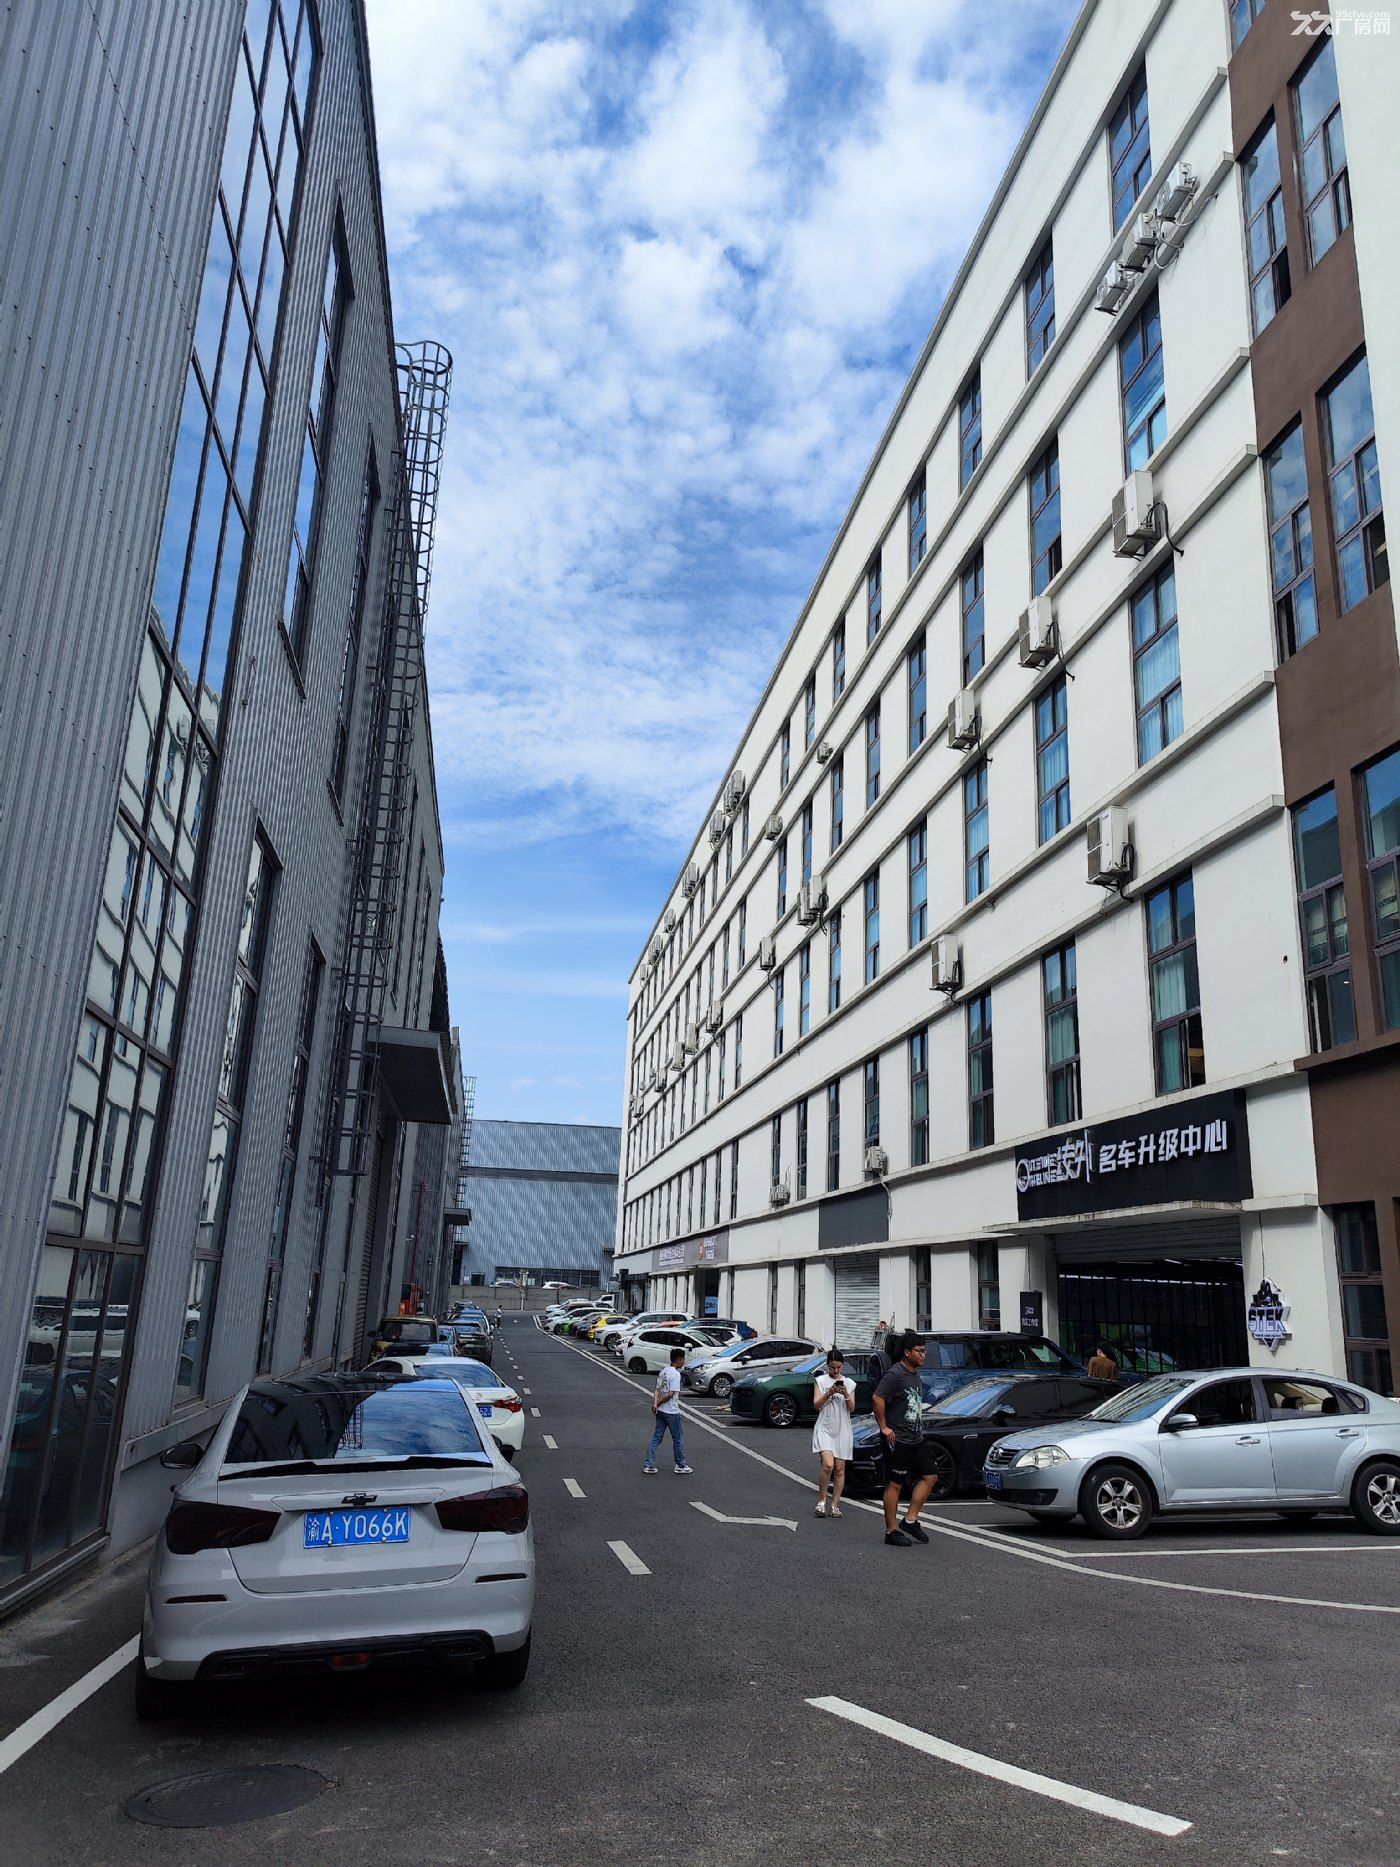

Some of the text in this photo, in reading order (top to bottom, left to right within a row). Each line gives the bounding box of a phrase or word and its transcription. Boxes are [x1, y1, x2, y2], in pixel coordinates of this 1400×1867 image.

[1099, 1118, 1228, 1174] 名车升级中心
